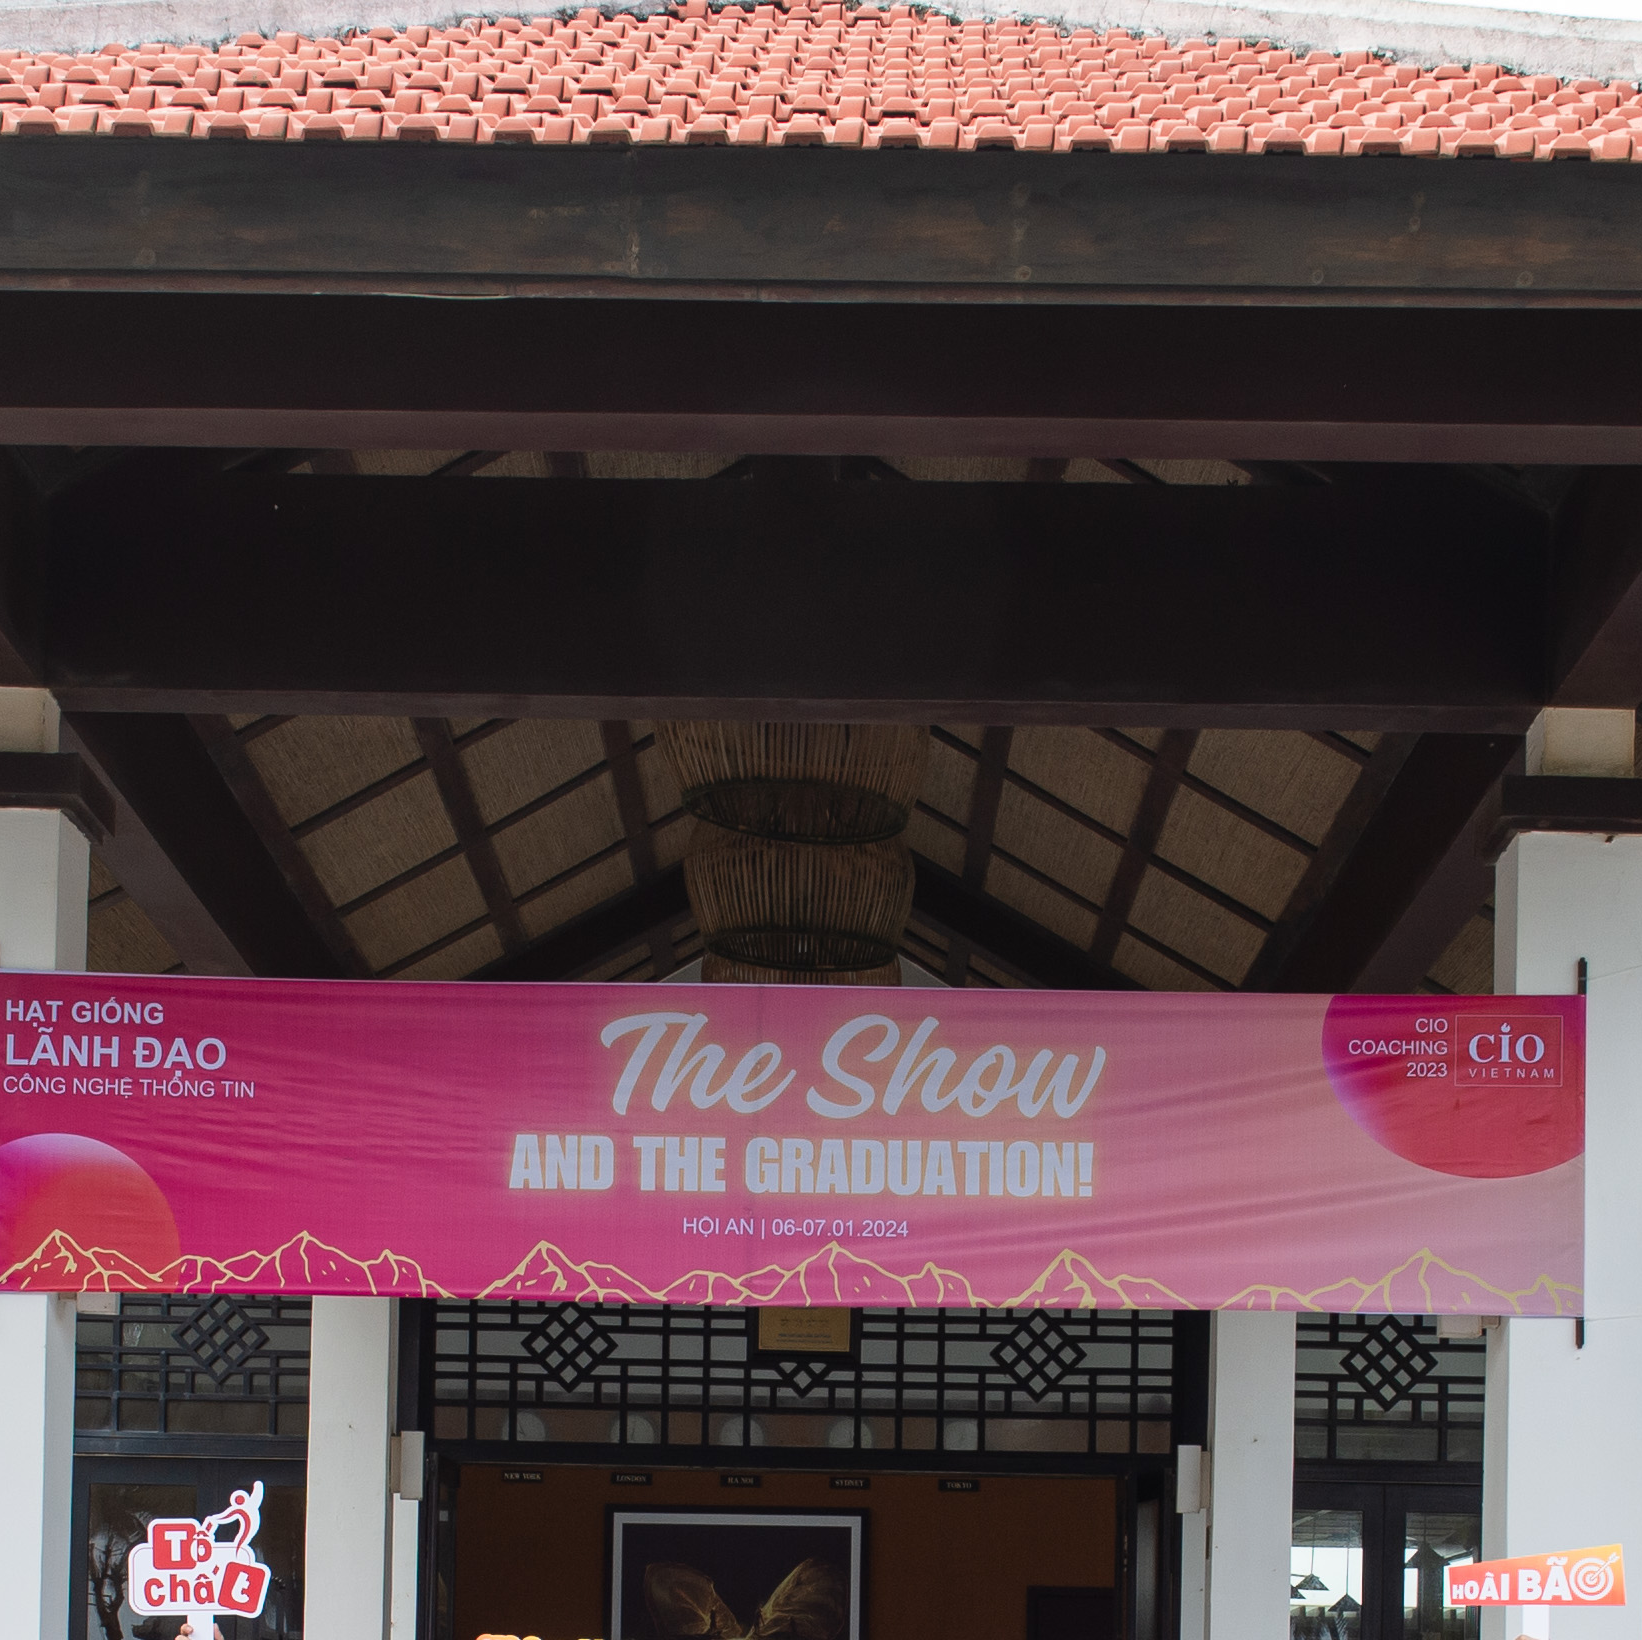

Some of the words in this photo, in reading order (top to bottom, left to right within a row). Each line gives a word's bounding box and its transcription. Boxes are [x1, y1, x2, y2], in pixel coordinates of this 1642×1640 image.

[5, 999, 64, 1028] HẠT
[71, 996, 165, 1025] GIỐNG
[1415, 1018, 1449, 1033] CIO
[5, 1026, 120, 1068] LÃNH
[132, 1036, 227, 1077] ĐẠO
[1348, 1039, 1448, 1055] COACHING
[600, 1012, 797, 1116] The
[806, 1014, 1107, 1119] Show
[1406, 1062, 1448, 1078] 2023
[1468, 1067, 1555, 1079] VIETNAM
[3, 1072, 66, 1095] CÔNG
[72, 1077, 133, 1099] NGHỆ
[139, 1076, 215, 1098] THÔNG
[221, 1080, 255, 1098] TIN
[508, 1133, 616, 1191] AND
[633, 1136, 727, 1193] THE
[744, 1138, 1095, 1198] GRADUATION!
[683, 1215, 721, 1238] HỘI
[723, 1218, 755, 1236] AN
[771, 1218, 909, 1238] 06-07.01.2024
